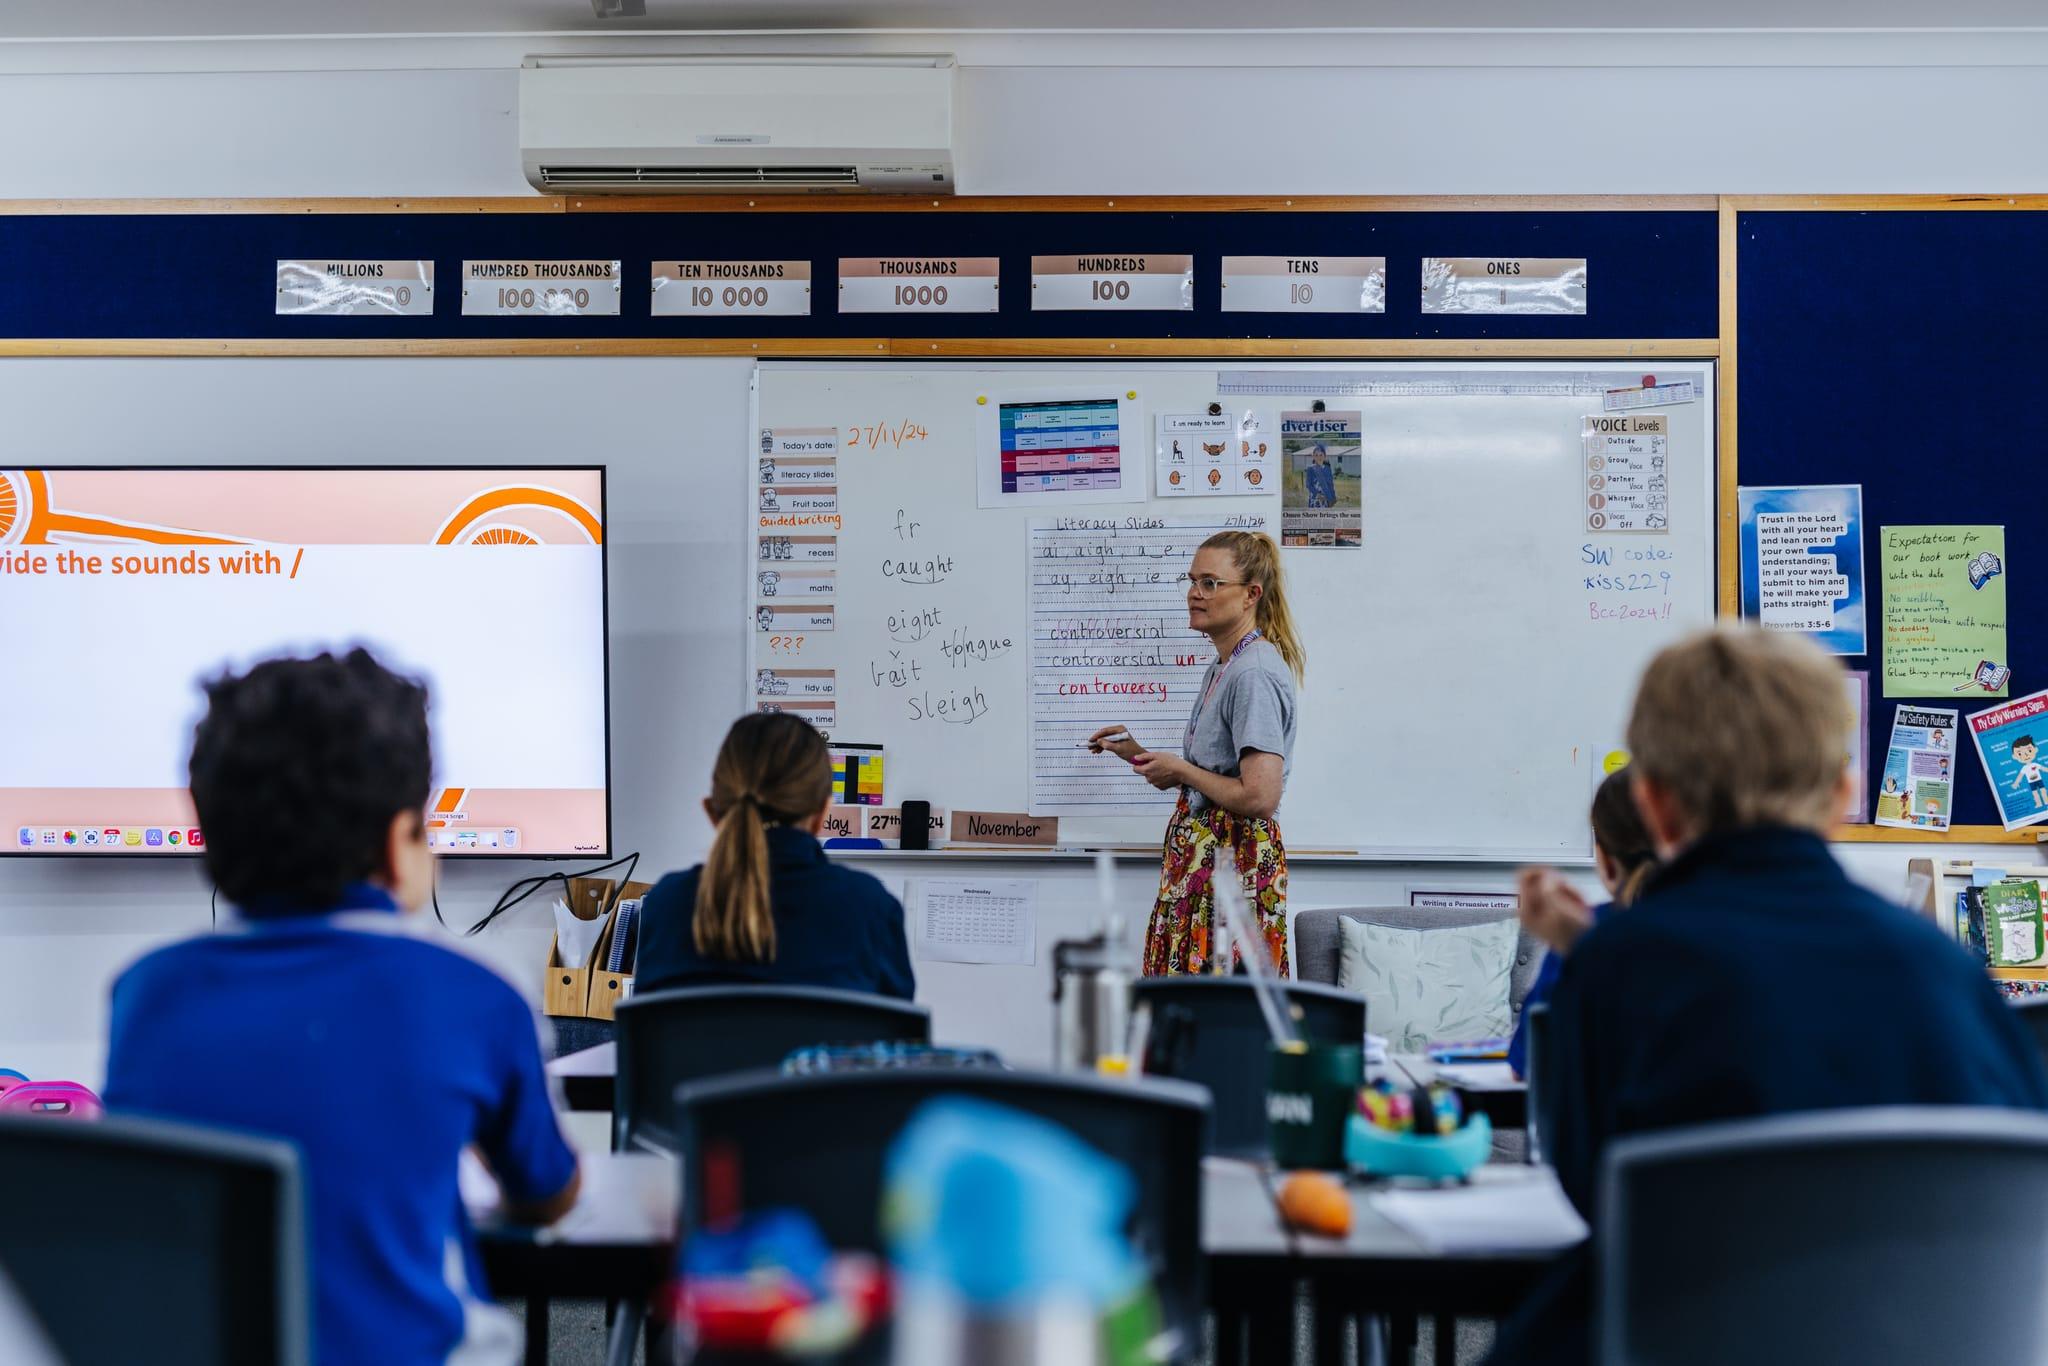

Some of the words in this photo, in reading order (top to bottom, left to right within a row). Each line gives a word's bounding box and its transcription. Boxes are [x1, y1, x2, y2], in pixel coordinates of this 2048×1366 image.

[327, 263, 384, 277] MILLIONS
[471, 264, 529, 277] HUNDRED
[534, 264, 611, 277] THOUSANDS
[678, 264, 701, 278] TEN
[707, 264, 784, 278] THOUSANDS
[879, 261, 957, 275] THOUSANDS
[1078, 258, 1145, 272] HUNDREDS
[1287, 260, 1319, 274] TENS
[1487, 261, 1521, 275] ONES
[692, 287, 714, 307] 10
[722, 286, 768, 307] 000
[895, 285, 948, 306] 1000
[1092, 280, 1130, 301] 100
[1291, 283, 1313, 304] 10
[498, 288, 535, 309] 100
[1187, 420, 1202, 430] ready
[1204, 419, 1211, 427] to
[1212, 418, 1225, 427] learn
[1592, 418, 1627, 432] VOICE
[1633, 417, 1660, 431] Levels
[848, 419, 929, 452] 27/11/24
[1607, 437, 1635, 445] Outside
[783, 442, 812, 451] Today's
[1607, 456, 1628, 465] Group
[781, 471, 811, 480] literacy
[813, 470, 834, 479] slides
[1607, 475, 1636, 483] Partner
[792, 501, 811, 509] Fruit
[812, 500, 835, 508] boost
[1607, 495, 1636, 503] Whisper
[893, 508, 921, 541] fr
[1619, 521, 1633, 529] Off
[1761, 516, 1784, 524] Trust
[1798, 515, 1813, 523] the
[1815, 514, 1837, 523] Lord
[1056, 517, 1117, 539] Literacy
[1126, 516, 1166, 530] Slides
[1761, 527, 1781, 535] with
[1783, 526, 1795, 534] all
[1797, 526, 1818, 535] your
[1820, 525, 1844, 533] heart
[1761, 537, 1778, 545] and
[1781, 537, 1800, 545] lean
[1889, 533, 1956, 550] Expectations
[1963, 531, 1980, 546] for
[1581, 543, 1613, 567] SW
[1762, 548, 1782, 556] your
[1893, 554, 1911, 562] our
[1919, 552, 1941, 563] book
[1948, 550, 1971, 561] work
[57, 550, 102, 574] the
[111, 550, 210, 574] sounds
[219, 550, 281, 574] with
[289, 547, 304, 579] /
[1762, 557, 1831, 566] understanding;
[881, 555, 954, 584] caught
[1762, 568, 1771, 576] in
[1774, 568, 1785, 576] all
[1788, 568, 1808, 577] your
[1810, 567, 1834, 576] ways
[1911, 569, 1924, 578] the
[1928, 567, 1944, 578] date
[809, 585, 834, 593] maths
[1763, 579, 1794, 587] submit
[1809, 578, 1826, 586] him
[1828, 578, 1845, 586] and
[1763, 590, 1774, 598] he
[1777, 589, 1793, 597] will
[1796, 589, 1820, 597] make
[1822, 589, 1843, 598] your
[1764, 600, 1789, 609] paths
[1791, 600, 1830, 608] straight.
[810, 617, 832, 625] lunch
[887, 607, 942, 642] eight
[1807, 620, 1831, 629] 3:5-6
[1050, 621, 1166, 642] controversial
[1052, 646, 1166, 668] controversial
[805, 684, 820, 693] tidy
[822, 685, 834, 693] up
[815, 715, 834, 724] time
[1907, 713, 1930, 727] Safety
[1930, 714, 1949, 727] Rules
[967, 815, 1041, 838] November
[1422, 899, 1447, 908] Writing
[1490, 901, 1511, 909] Letter
